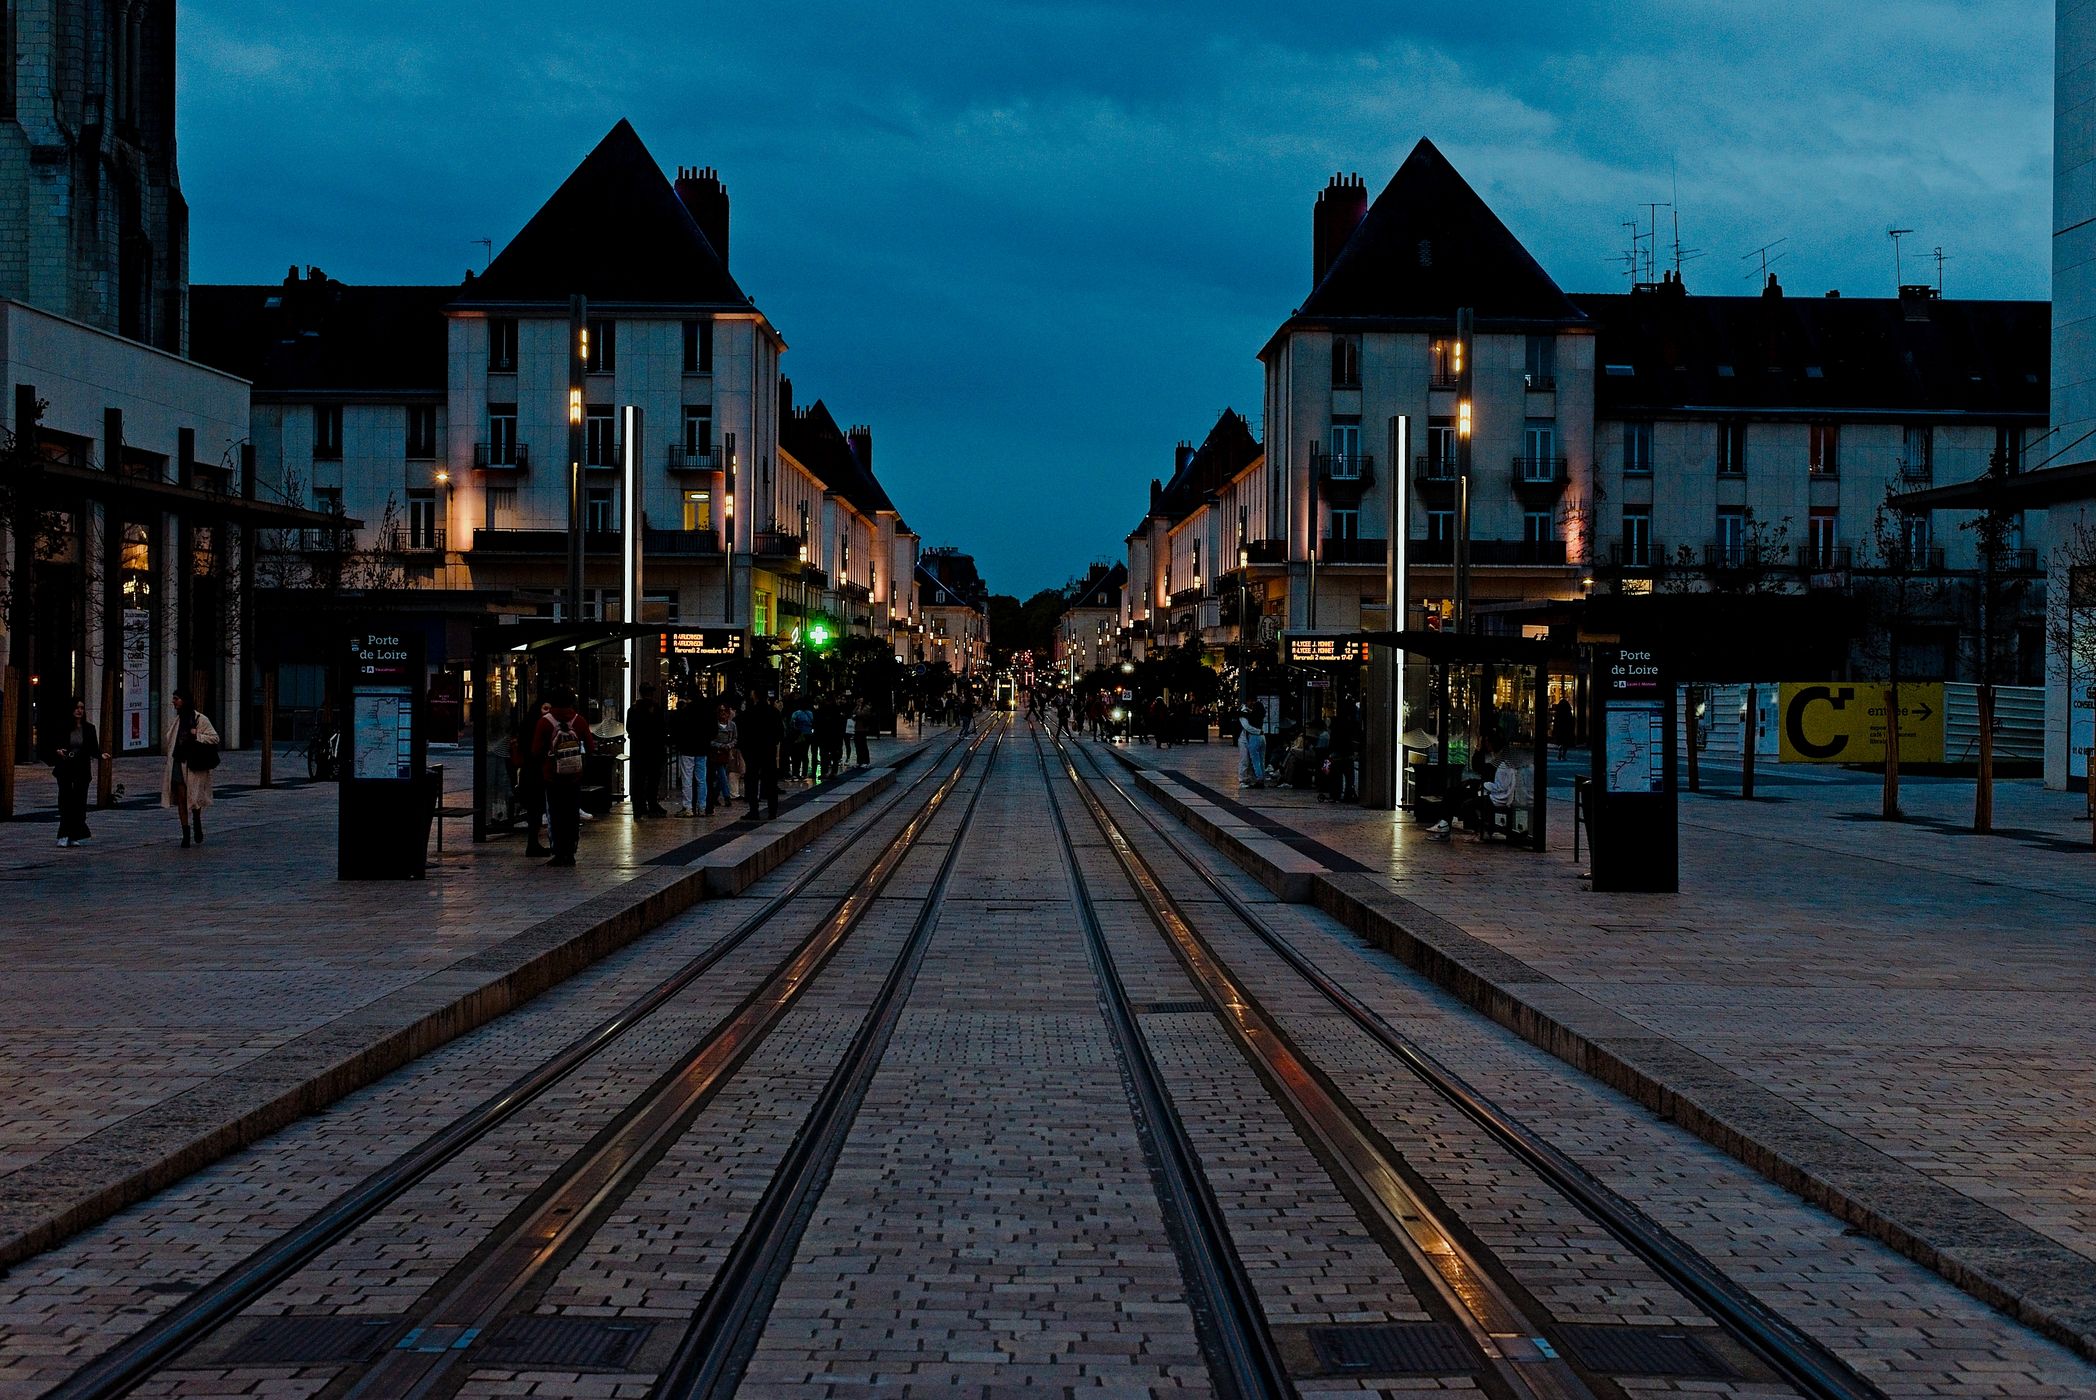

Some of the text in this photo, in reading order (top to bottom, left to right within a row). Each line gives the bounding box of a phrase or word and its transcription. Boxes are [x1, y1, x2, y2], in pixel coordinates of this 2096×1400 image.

[367, 635, 399, 645] Porte
[359, 649, 408, 660] de Loire
[1619, 650, 1651, 660] Porte
[1611, 664, 1659, 675] de Loire
